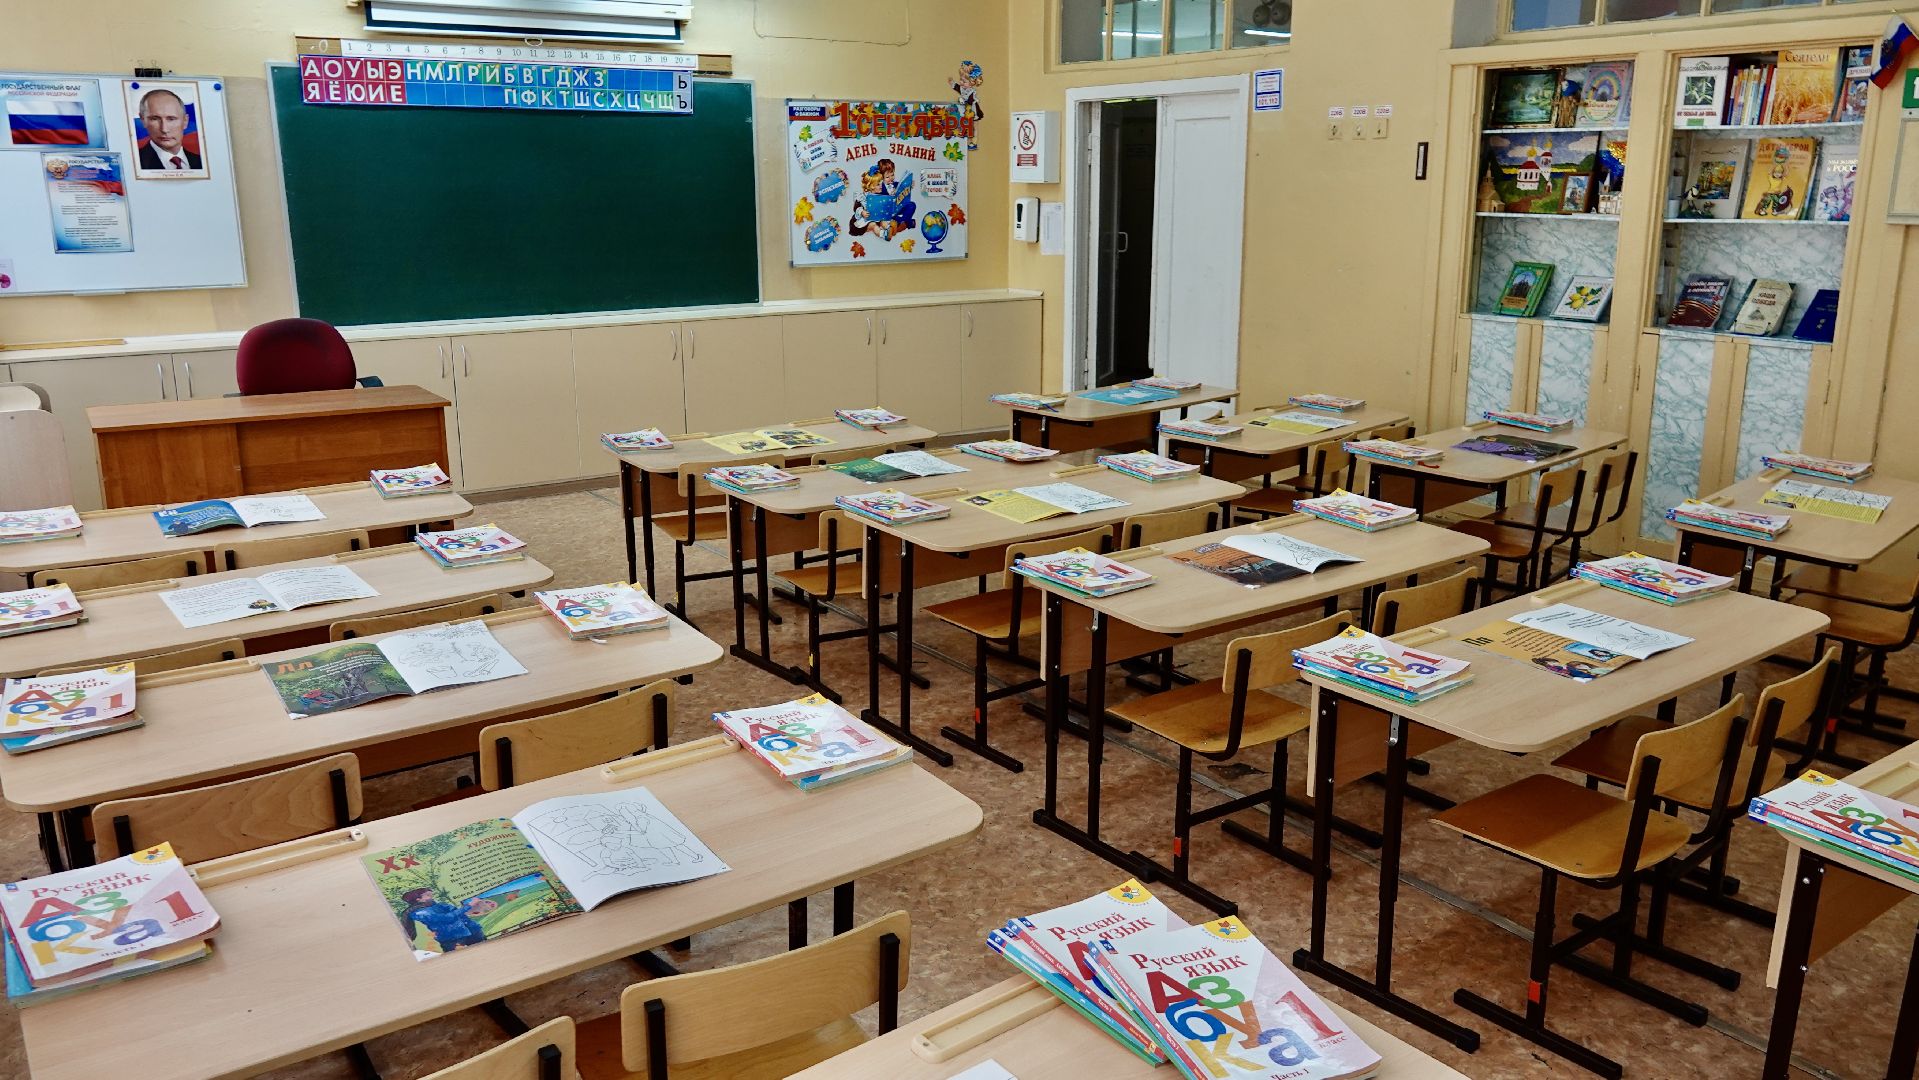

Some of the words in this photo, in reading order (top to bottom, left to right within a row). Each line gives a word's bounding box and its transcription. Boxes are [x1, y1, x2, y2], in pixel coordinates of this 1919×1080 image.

[347, 43, 353, 51] 1
[367, 43, 372, 52] 2
[386, 44, 392, 52] 3
[405, 45, 410, 53] 4
[424, 45, 429, 53] 5
[442, 46, 448, 54] 6
[460, 47, 466, 55] 7
[478, 47, 484, 55] 8
[496, 48, 502, 56] 9
[512, 48, 522, 57] 10
[529, 49, 538, 57] 11
[547, 50, 556, 58] 12
[563, 51, 573, 59] 13
[580, 51, 589, 59] 14
[596, 53, 604, 61] 15
[628, 54, 637, 62] 17
[644, 55, 653, 63] 18
[675, 56, 683, 64] 20
[835, 102, 856, 138] 1
[857, 113, 974, 138] СЕНТЯБРЯ
[845, 143, 878, 162] ДЕНЬ
[889, 142, 936, 161] ЗНАНИЙ
[1402, 651, 1444, 665] 1
[102, 693, 128, 710] 1
[741, 710, 802, 725] Русский
[835, 725, 877, 747] 1
[31, 872, 130, 898] Русский
[155, 891, 205, 923] 1
[1048, 912, 1127, 942] Русский
[1128, 946, 1218, 971] Русский
[1275, 990, 1343, 1042] 1
[1318, 1034, 1348, 1050] класс
